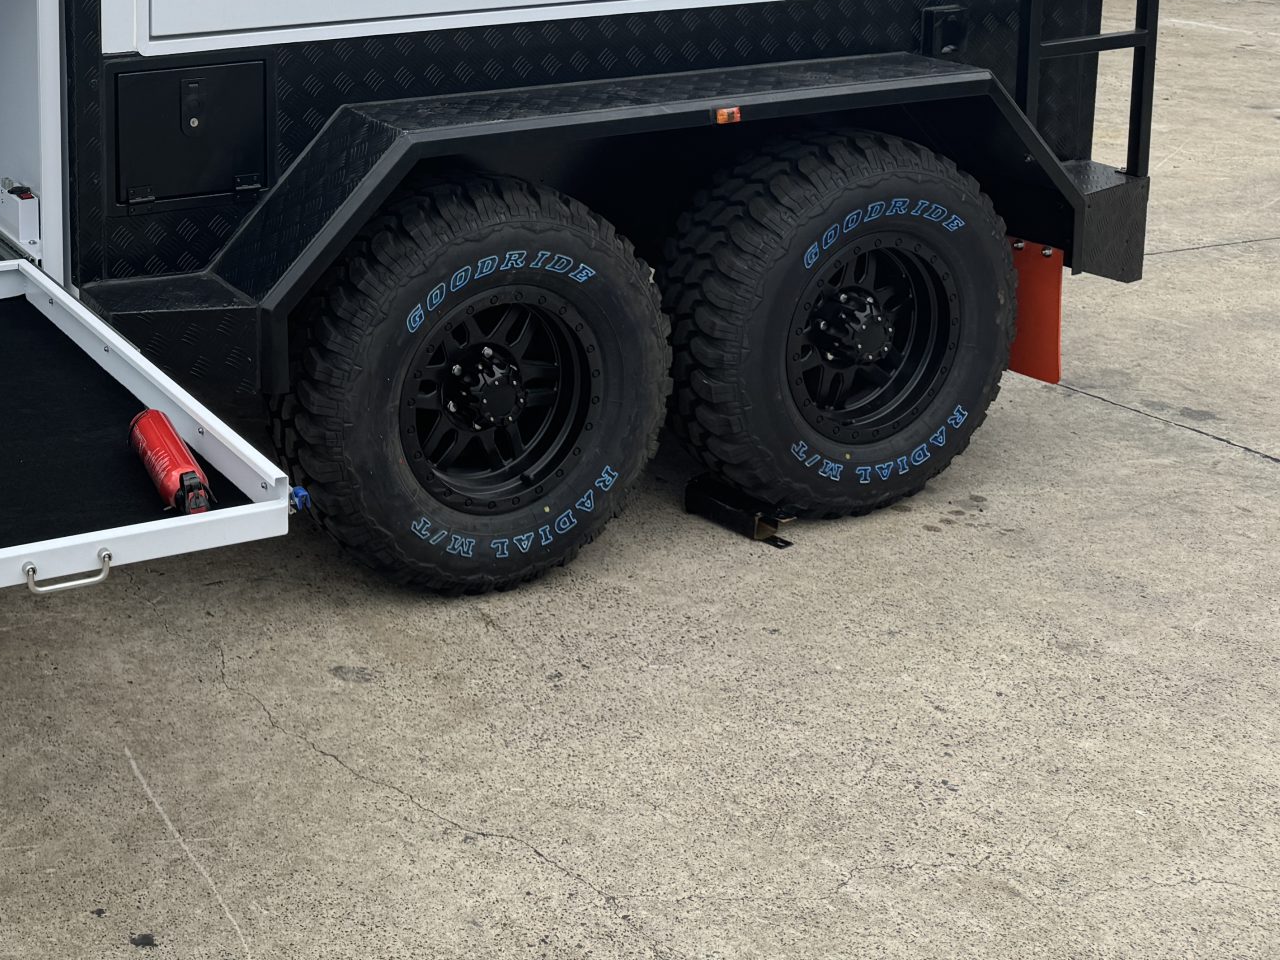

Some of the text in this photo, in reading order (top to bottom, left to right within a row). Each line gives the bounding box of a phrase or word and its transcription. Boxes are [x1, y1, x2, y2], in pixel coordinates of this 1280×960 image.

[803, 198, 966, 269] GOODRIDE
[406, 250, 596, 333] GOODRIDE
[791, 405, 969, 484] RADIAL M/T
[411, 466, 619, 558] RADIAL M/T
